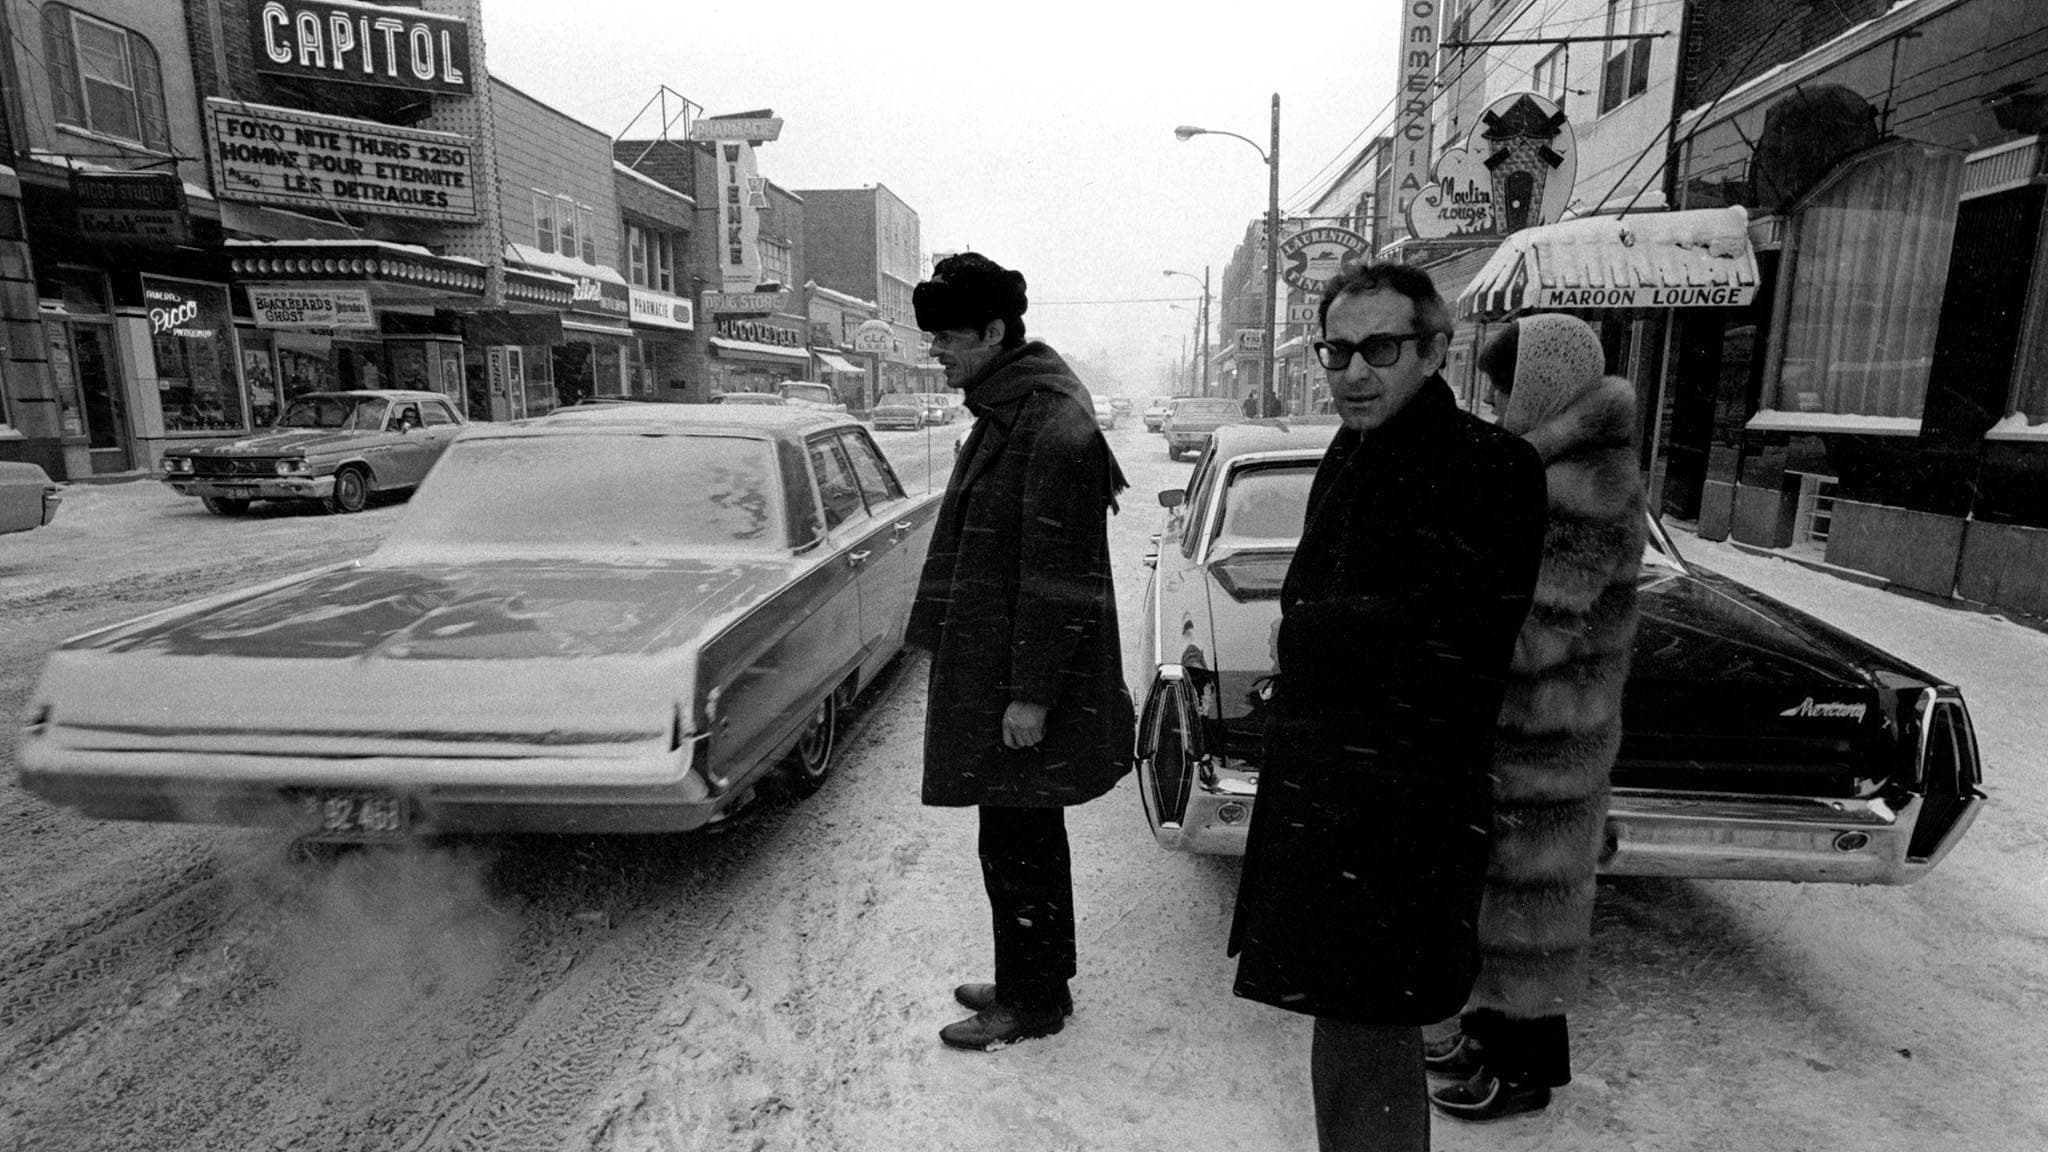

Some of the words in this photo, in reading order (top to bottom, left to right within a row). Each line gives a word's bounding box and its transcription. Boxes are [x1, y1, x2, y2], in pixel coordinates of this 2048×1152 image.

[262, 2, 464, 86] CAPITOL
[1399, 0, 1434, 214] OMMERCIAL
[696, 120, 775, 137] PHARMACIE
[227, 118, 285, 142] FOTO
[295, 128, 341, 151] NITE
[346, 135, 411, 159] THURS
[418, 145, 465, 166] $250
[220, 141, 299, 168] HOMME
[308, 153, 363, 176] POUR
[375, 162, 465, 188] ETERNITE
[228, 167, 260, 188] ALSO
[283, 174, 323, 194] LES
[333, 180, 448, 208] DETRAQUES
[1425, 176, 1491, 207] Moulin
[81, 215, 135, 233] Kodak
[1438, 206, 1487, 225] rouge
[1282, 230, 1365, 256] LAURENTIDE
[1288, 271, 1325, 292] FINA
[634, 298, 669, 318] PHARMACIE
[1550, 290, 1635, 305] MAROON
[1652, 288, 1741, 305] LOUNGE
[150, 301, 198, 335] Picco
[265, 310, 304, 322] GHOST
[1780, 697, 1866, 723] Mercury
